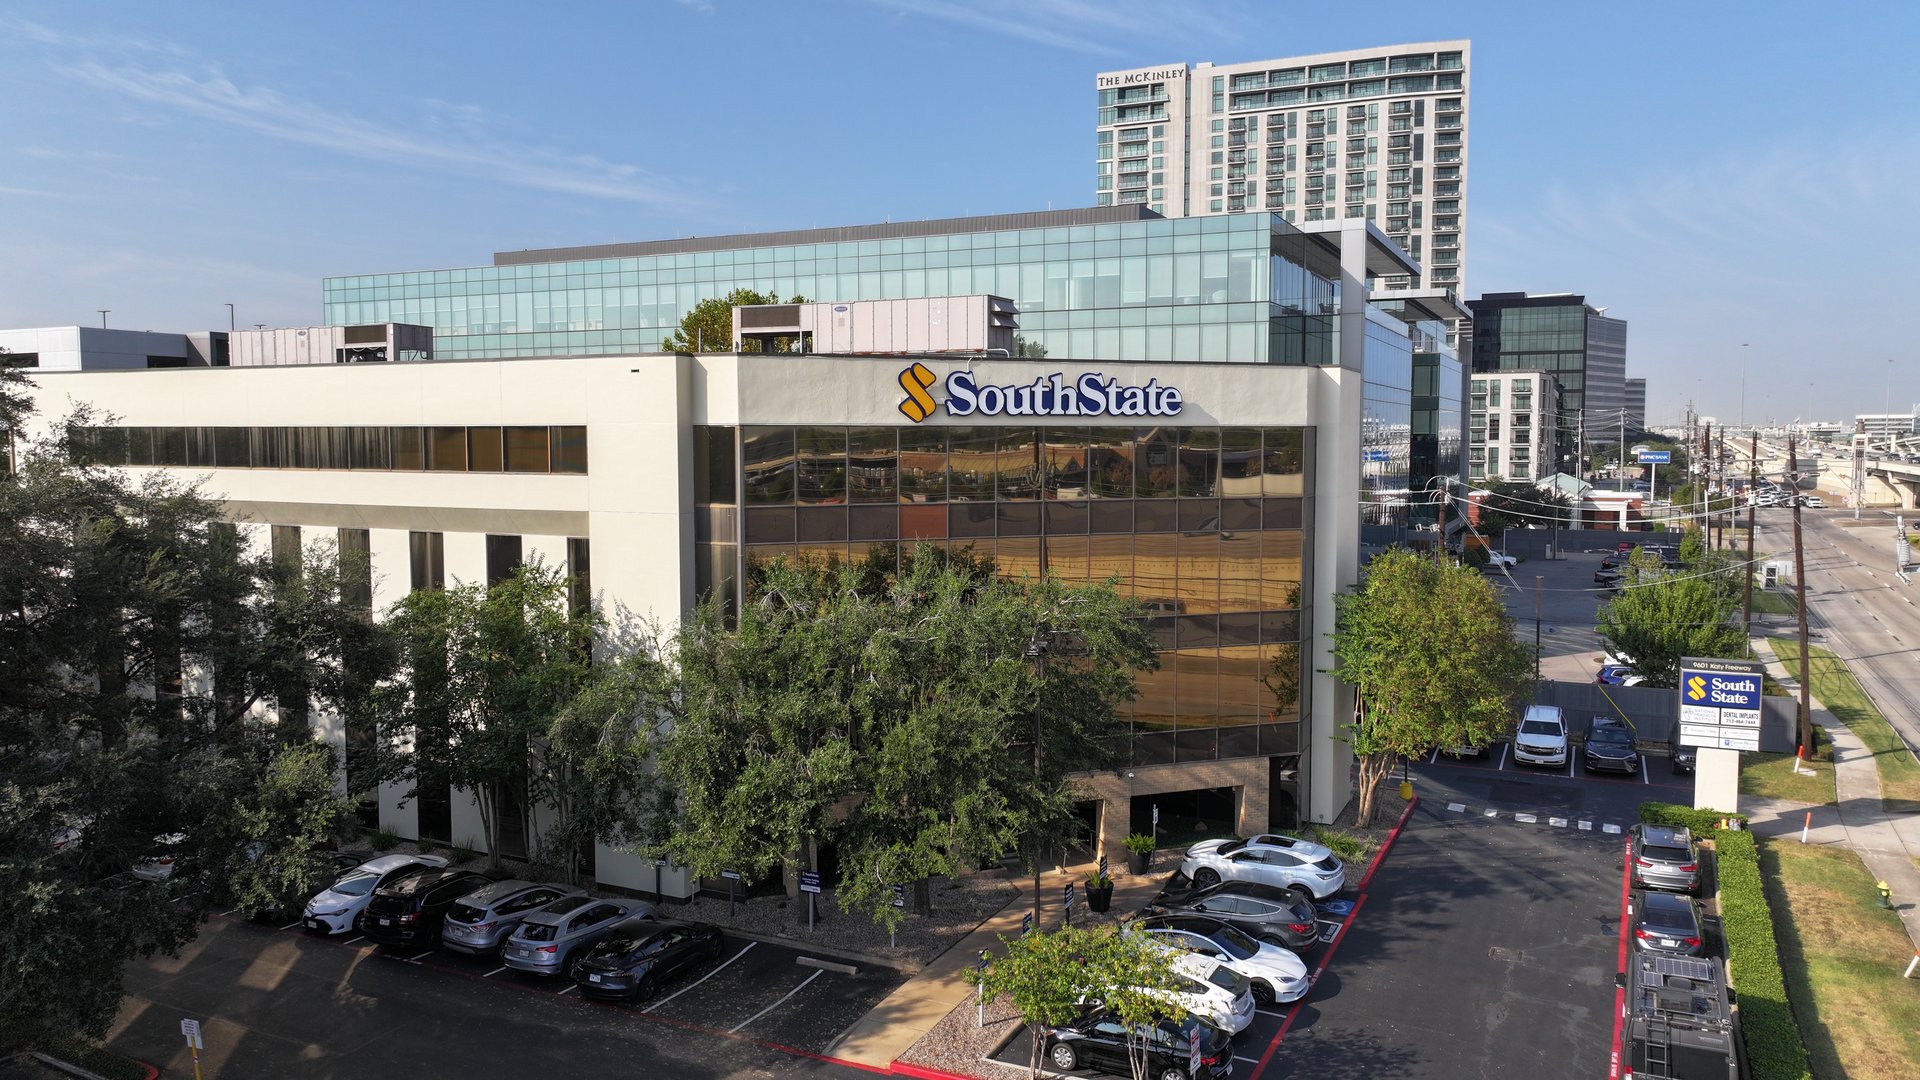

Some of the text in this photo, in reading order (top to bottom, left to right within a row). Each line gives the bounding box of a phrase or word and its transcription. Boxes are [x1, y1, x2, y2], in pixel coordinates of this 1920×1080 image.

[1097, 77, 1120, 87] THE
[946, 371, 1183, 416] SouthState
[1692, 661, 1752, 672] 9601 Katy Freeway
[1711, 677, 1755, 692] South
[1711, 691, 1748, 704] State
[1723, 711, 1759, 720] DENTAL IMPLANTS
